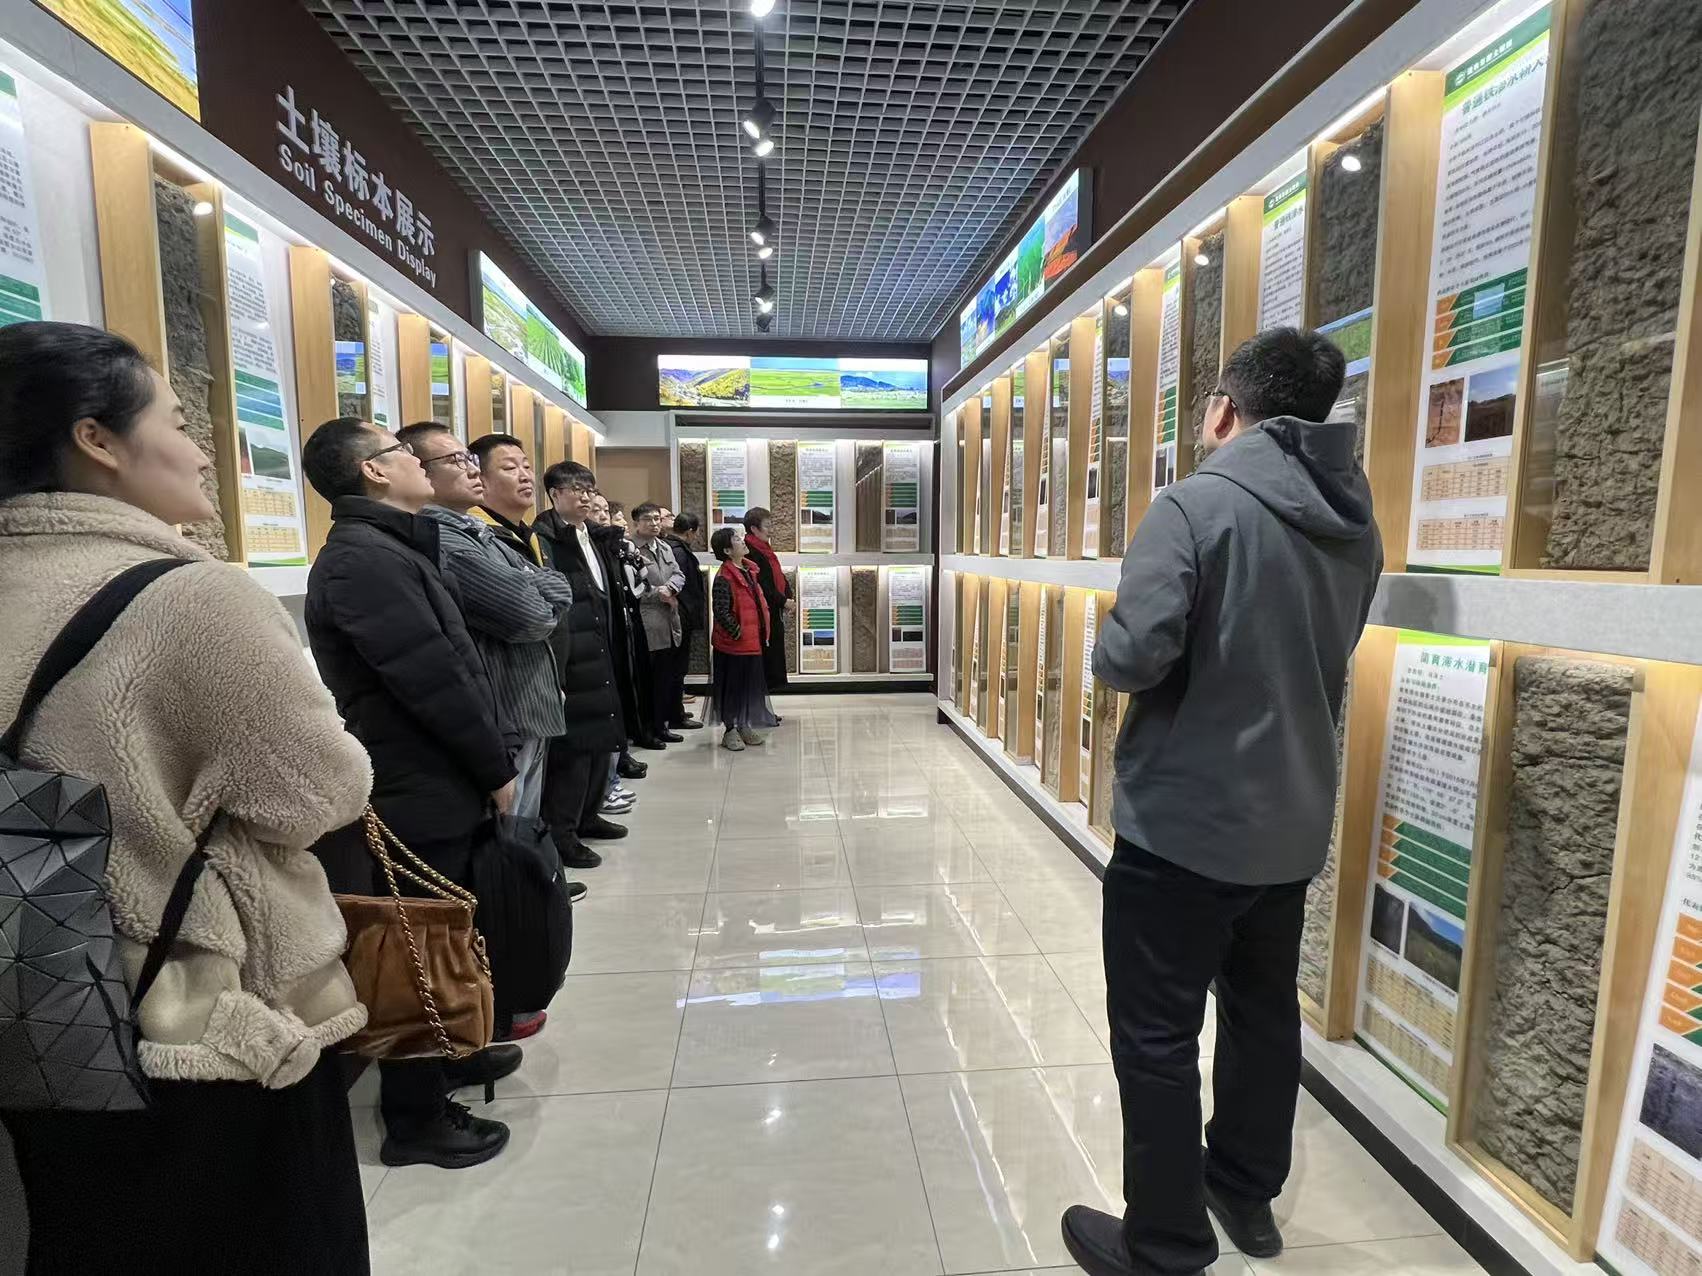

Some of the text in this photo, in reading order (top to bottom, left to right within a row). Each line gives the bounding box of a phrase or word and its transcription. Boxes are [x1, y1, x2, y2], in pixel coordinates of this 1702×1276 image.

[277, 85, 435, 255] 土壤标本展示
[279, 144, 436, 288] Soil Specimen Display
